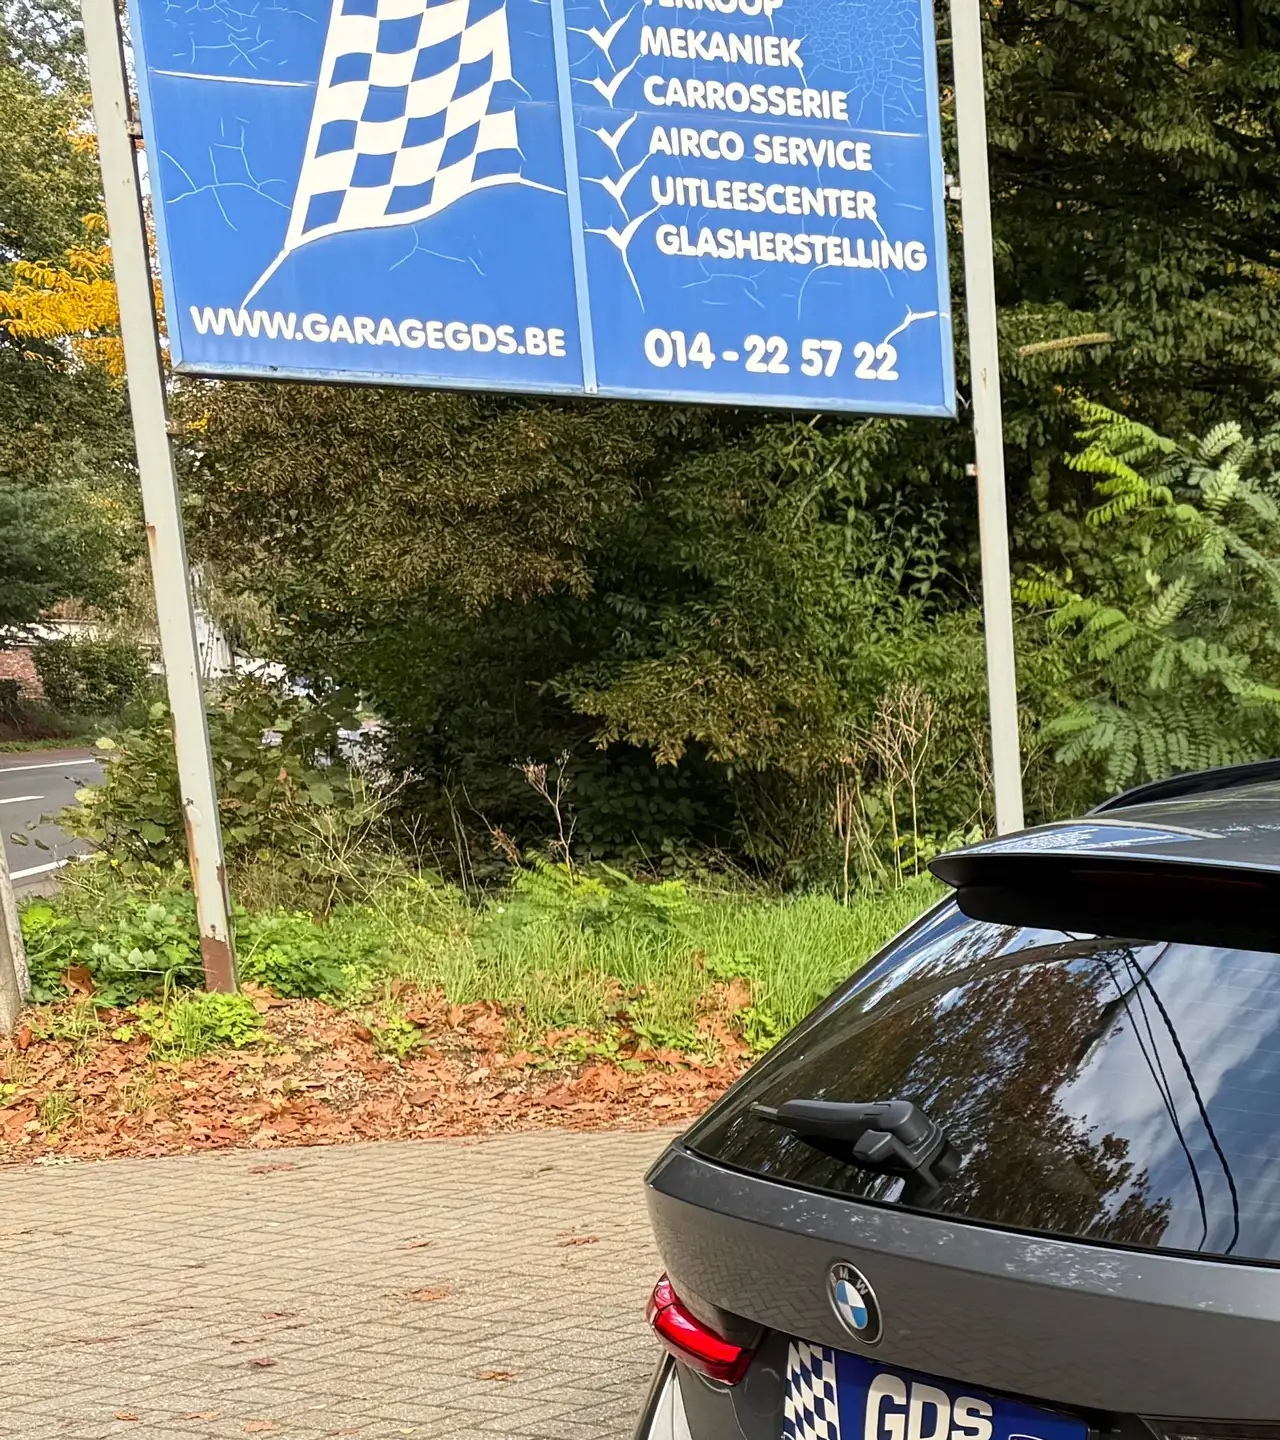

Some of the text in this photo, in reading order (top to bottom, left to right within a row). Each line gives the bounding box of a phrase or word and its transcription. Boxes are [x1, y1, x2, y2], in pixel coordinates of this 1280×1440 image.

[640, 26, 803, 68] MEKANIEK
[643, 75, 849, 121] CARROSSERIE
[649, 126, 872, 172] AIRCO SERVICE
[651, 175, 877, 219] UITLEESCENTER
[655, 224, 928, 272] GLASHERSTELLING
[189, 305, 567, 357] WWW.GARAGEGDS.BE
[644, 328, 715, 370] 014
[743, 334, 790, 374] 22
[800, 338, 842, 378] 57
[853, 341, 899, 381] 22
